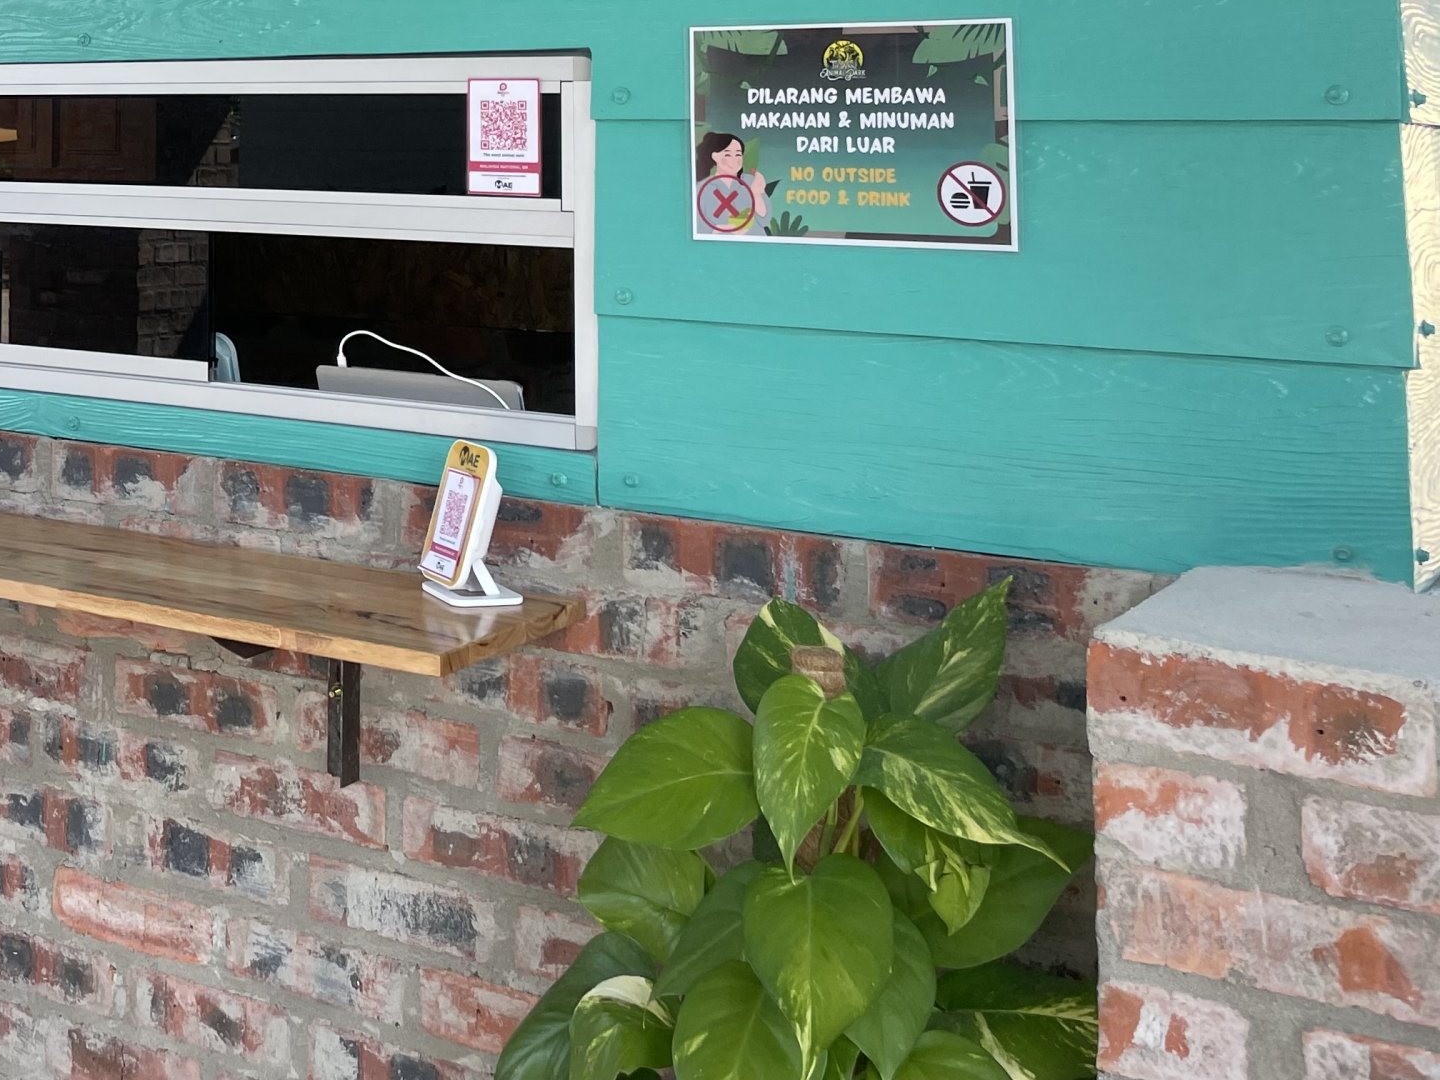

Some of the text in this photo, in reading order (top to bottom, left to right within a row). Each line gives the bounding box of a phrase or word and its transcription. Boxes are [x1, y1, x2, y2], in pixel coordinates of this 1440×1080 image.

[747, 87, 946, 106] DILARANG MEMBAWA
[740, 111, 955, 131] MAKANAN & MINUMAN
[796, 136, 895, 154] DARI LUAR
[790, 166, 897, 184] NO OUTSIDE
[786, 190, 910, 208] FOOD & DRINK
[459, 445, 481, 469] MAE
